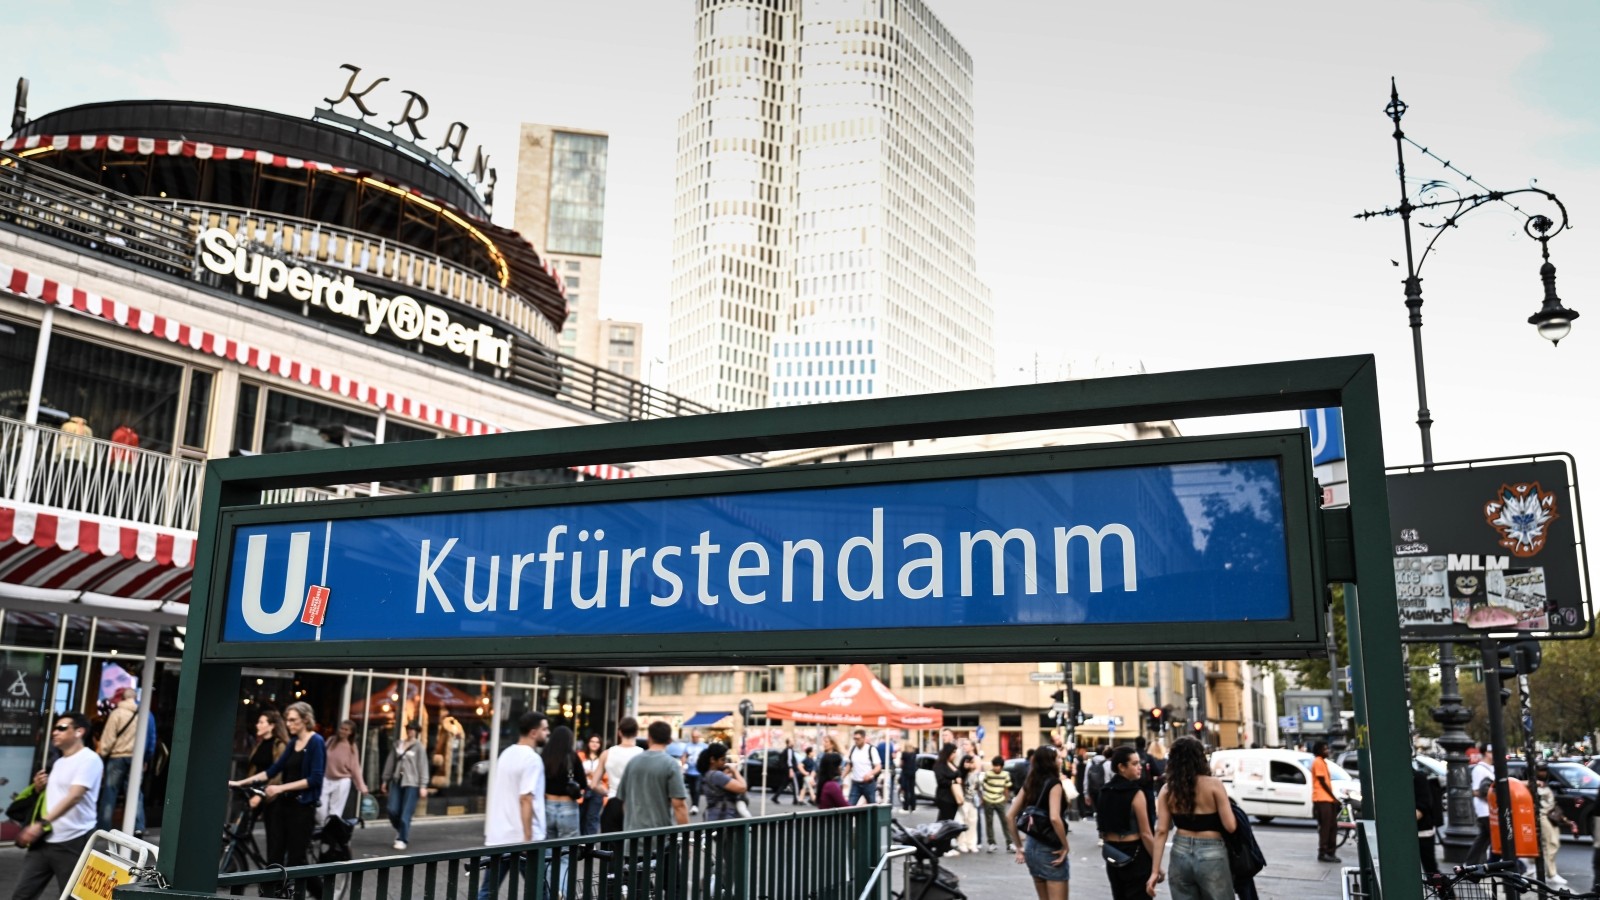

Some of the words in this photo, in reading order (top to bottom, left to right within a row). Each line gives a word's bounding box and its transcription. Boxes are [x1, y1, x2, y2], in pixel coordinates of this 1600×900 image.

[1447, 553, 1510, 571] MLM
[241, 531, 311, 635] U
[415, 507, 1138, 614] Kurfürstendamm
[1397, 584, 1445, 598] MORE
[1307, 706, 1319, 721] U
